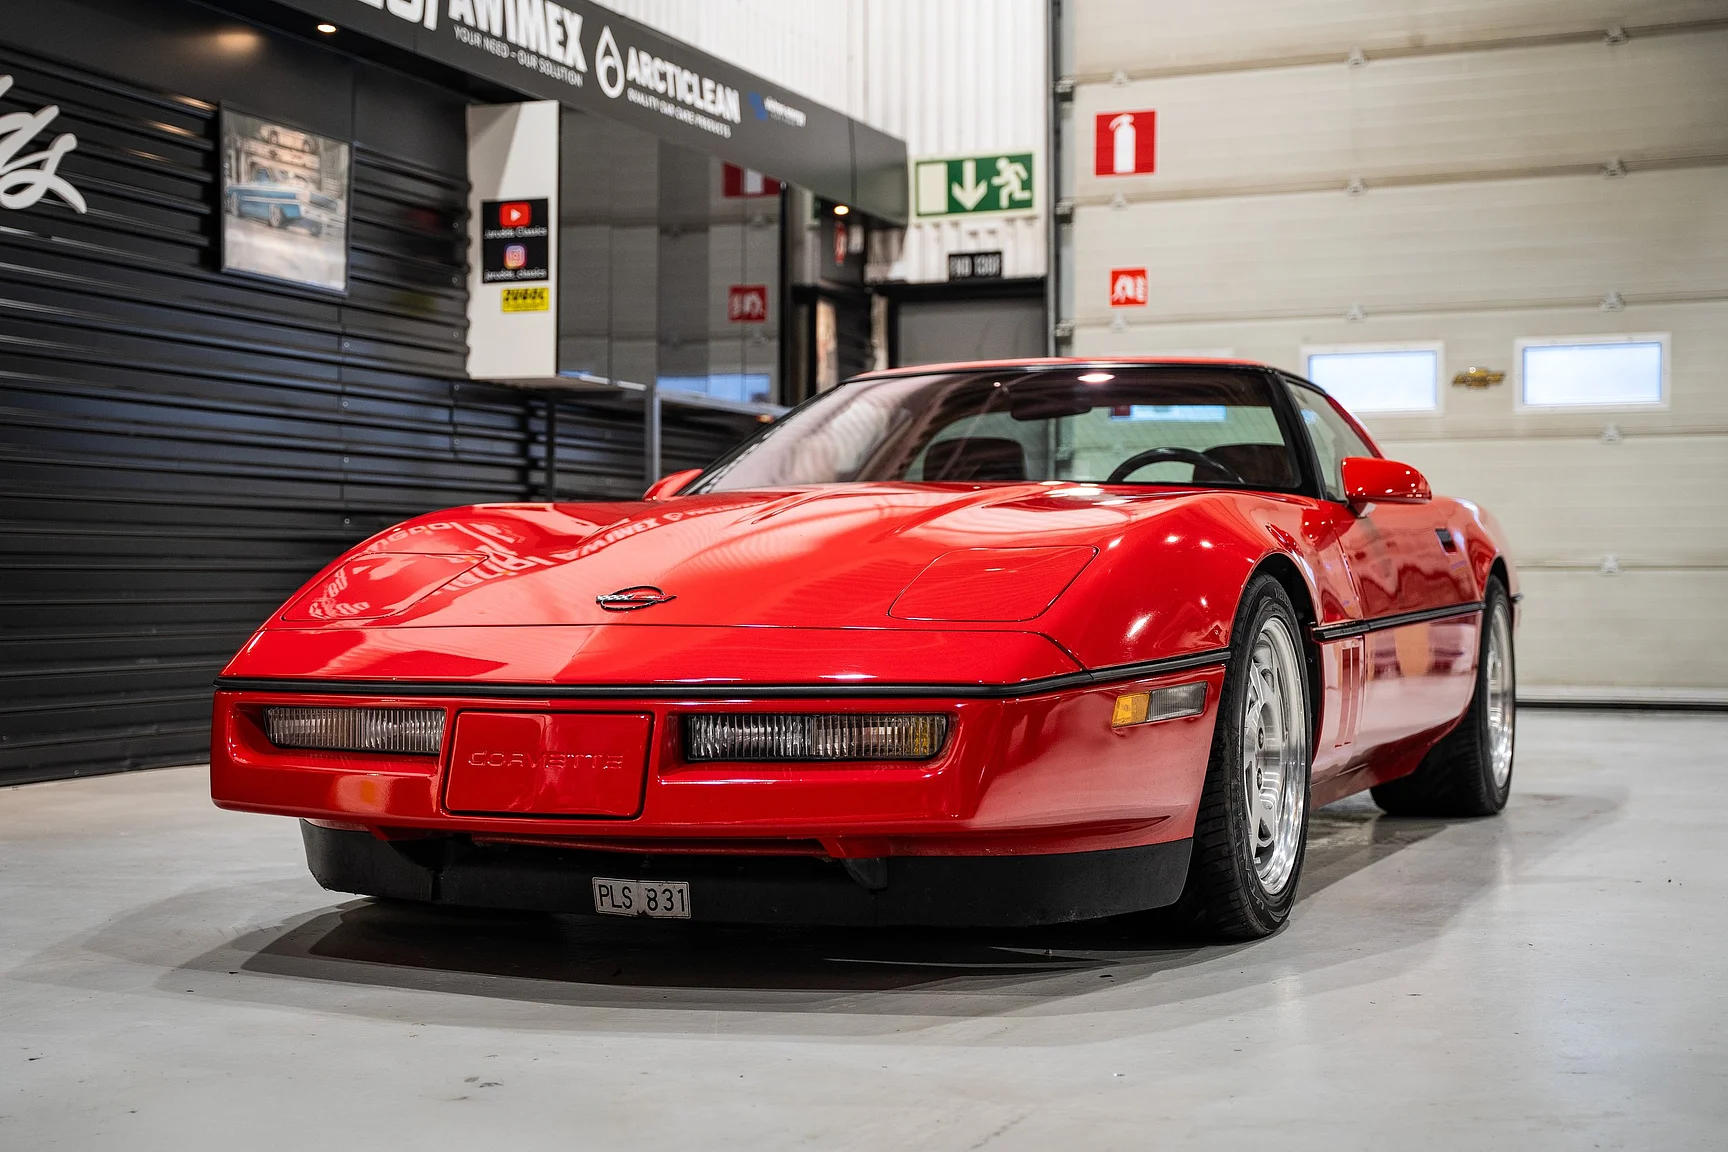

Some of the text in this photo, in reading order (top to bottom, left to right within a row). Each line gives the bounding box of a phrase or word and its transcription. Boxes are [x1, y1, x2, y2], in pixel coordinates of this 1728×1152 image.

[453, 24, 483, 47] YOUR
[483, 36, 510, 59] NEED
[517, 50, 538, 69] OUR
[538, 57, 584, 88] SOLUTION
[626, 46, 741, 124] ARCTICLEAN
[627, 87, 660, 110] QUALITY
[694, 113, 732, 139] PRODUCTS
[468, 751, 624, 769] CORVETTE
[598, 884, 685, 912] PLS 831
